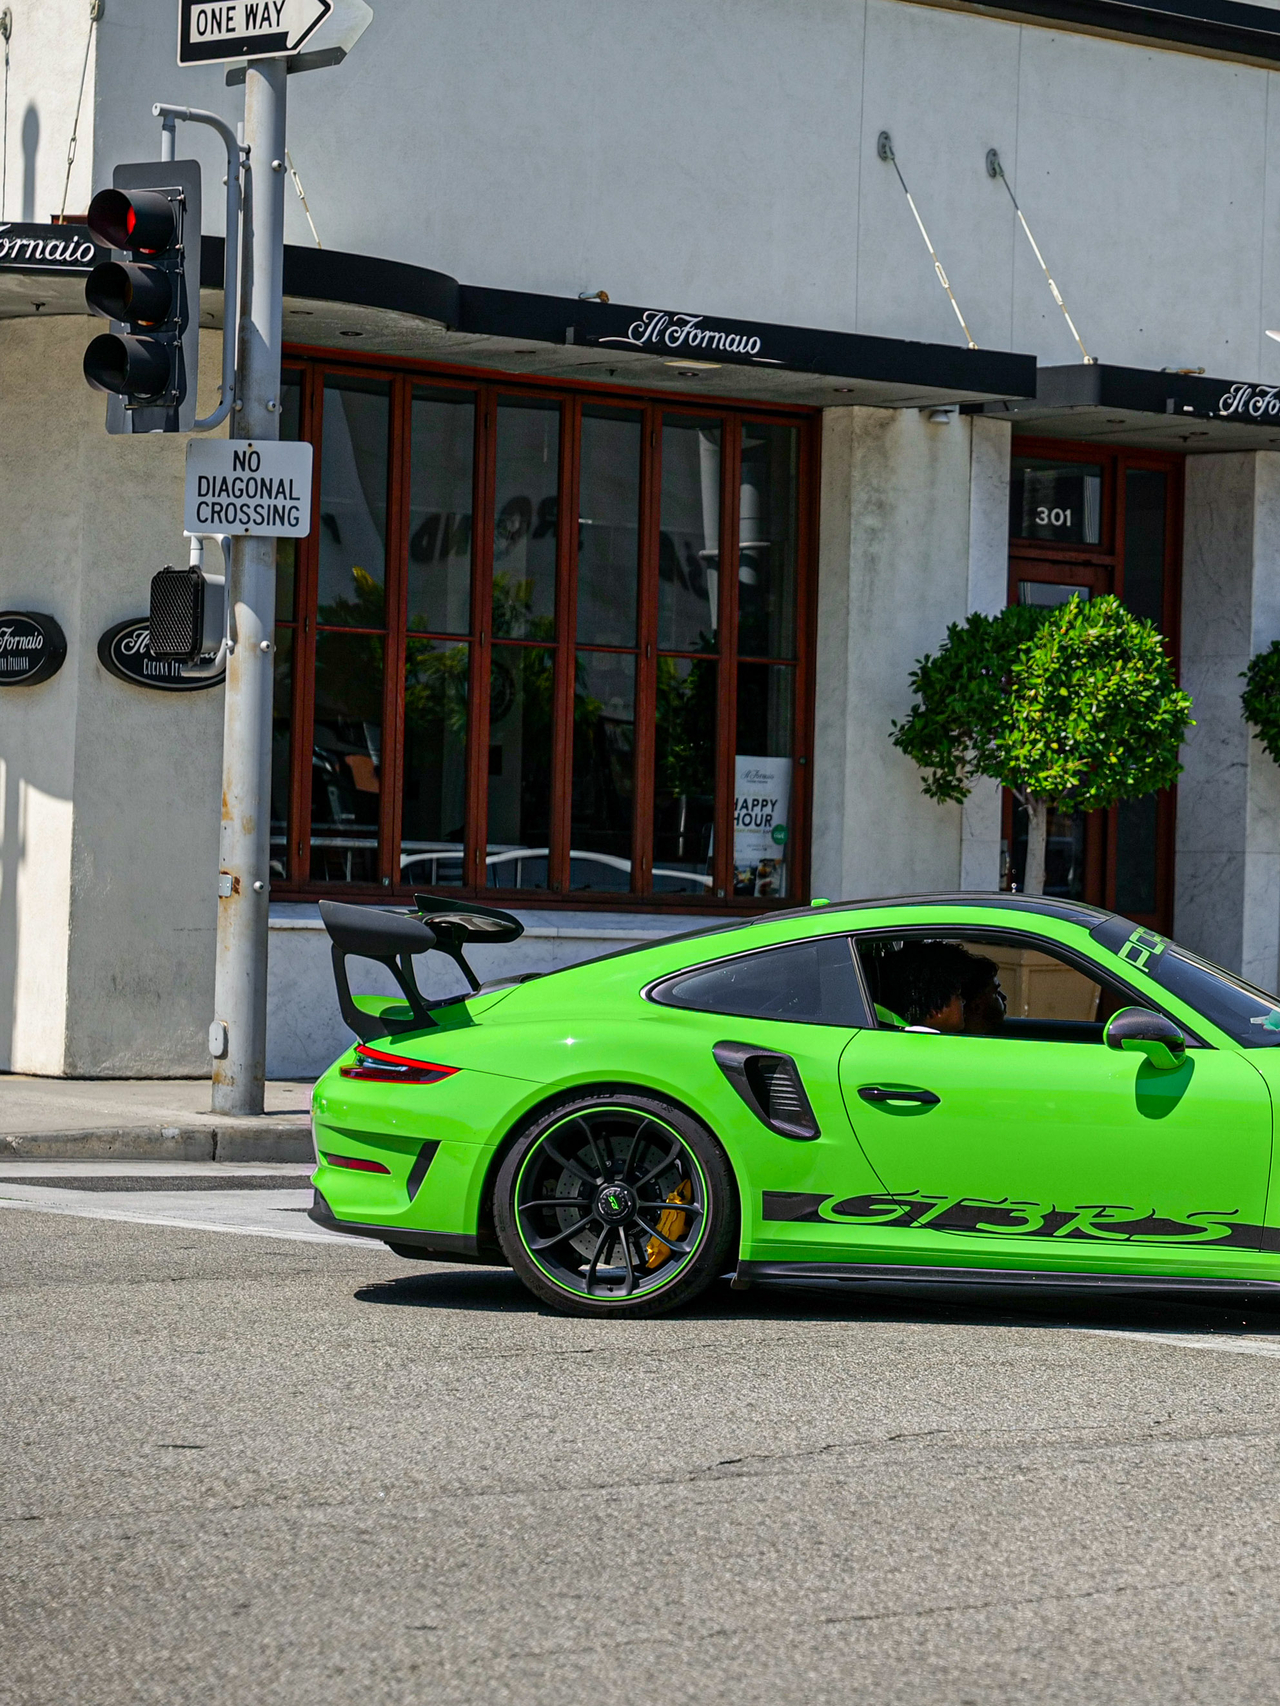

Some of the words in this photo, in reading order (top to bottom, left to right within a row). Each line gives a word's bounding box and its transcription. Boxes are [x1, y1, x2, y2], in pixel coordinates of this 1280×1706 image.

[196, 6, 236, 36] ONE
[245, 0, 285, 31] WAY
[628, 310, 669, 347] Il
[664, 314, 761, 354] Fornaio
[1219, 383, 1252, 414] Il
[233, 450, 261, 472] NO
[197, 475, 301, 501] DIAGONAL
[196, 501, 300, 527] CROSSING
[1035, 506, 1072, 527] 301
